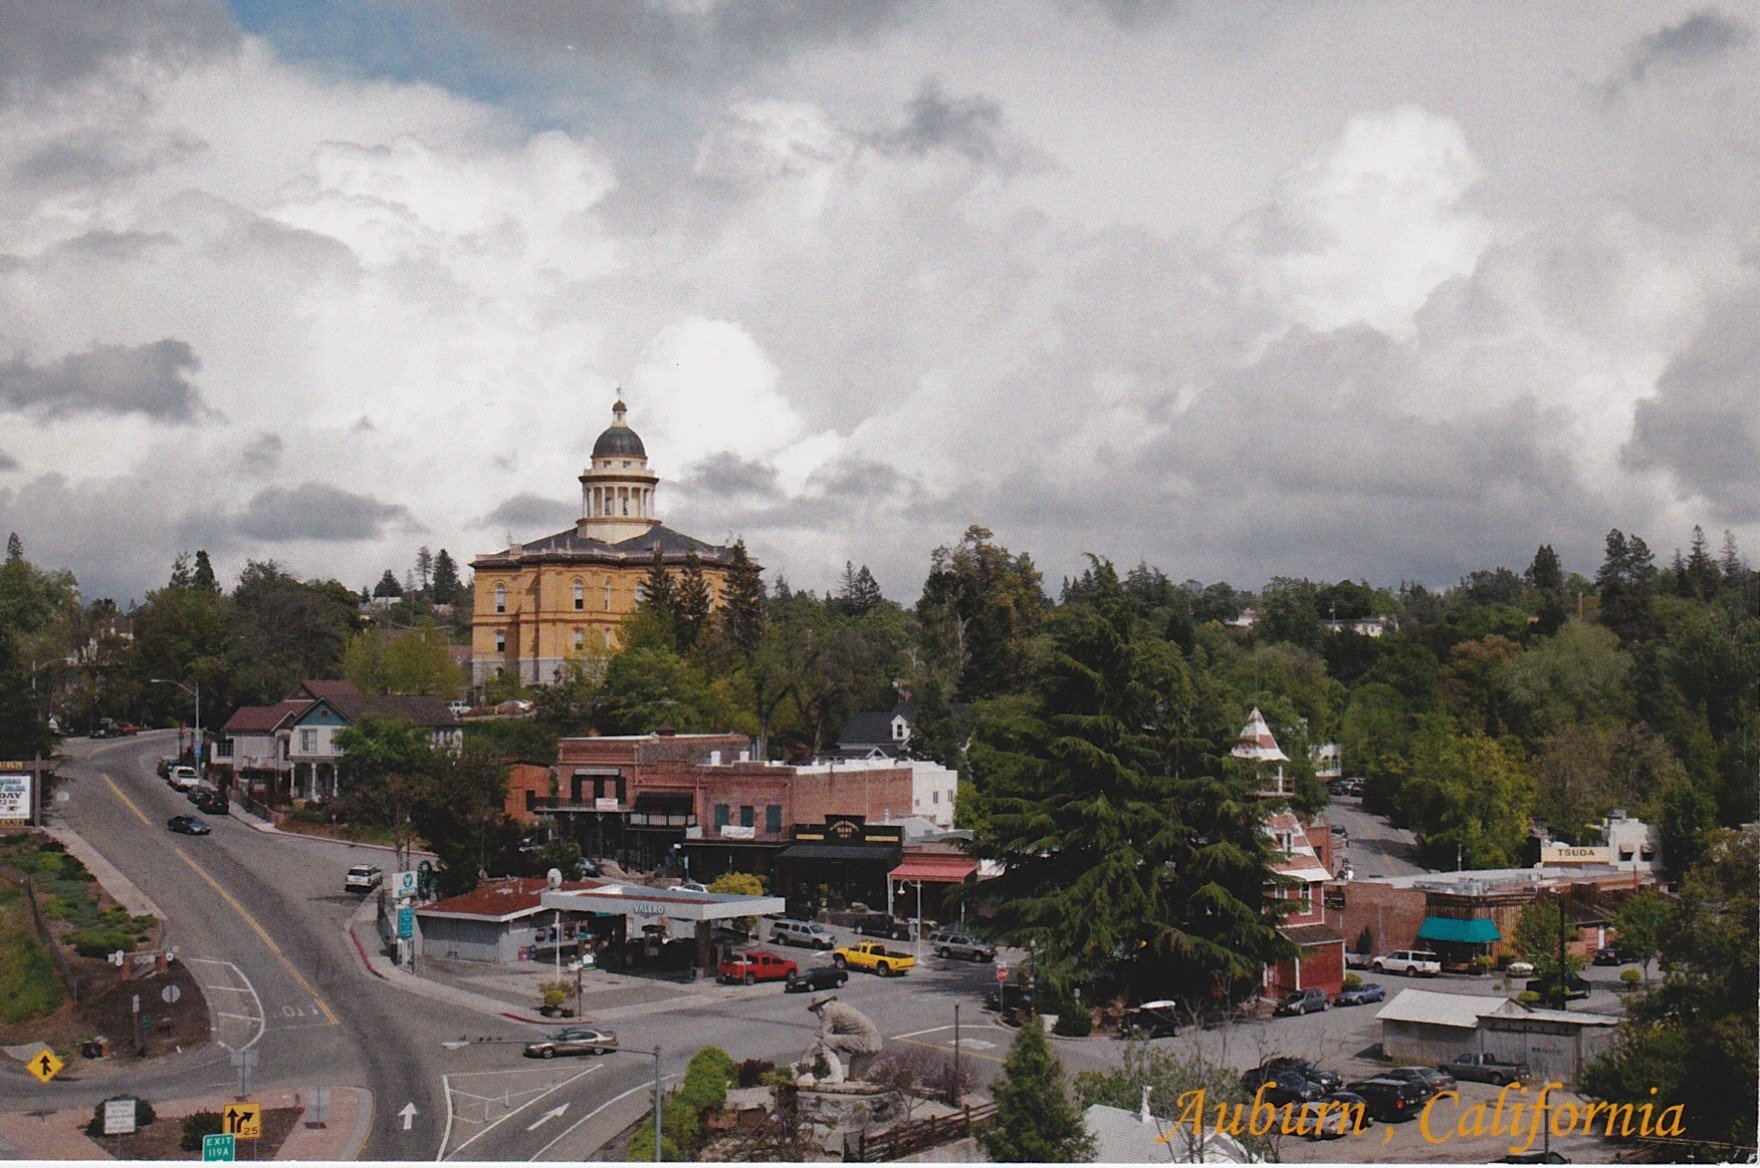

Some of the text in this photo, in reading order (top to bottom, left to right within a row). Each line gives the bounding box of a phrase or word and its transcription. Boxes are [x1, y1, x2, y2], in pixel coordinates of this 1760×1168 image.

[1557, 848, 1595, 857] TSUDA
[634, 904, 665, 915] VALERO
[243, 1126, 258, 1136] 25
[206, 1136, 232, 1146] EXIT
[208, 1147, 229, 1157] 119A
